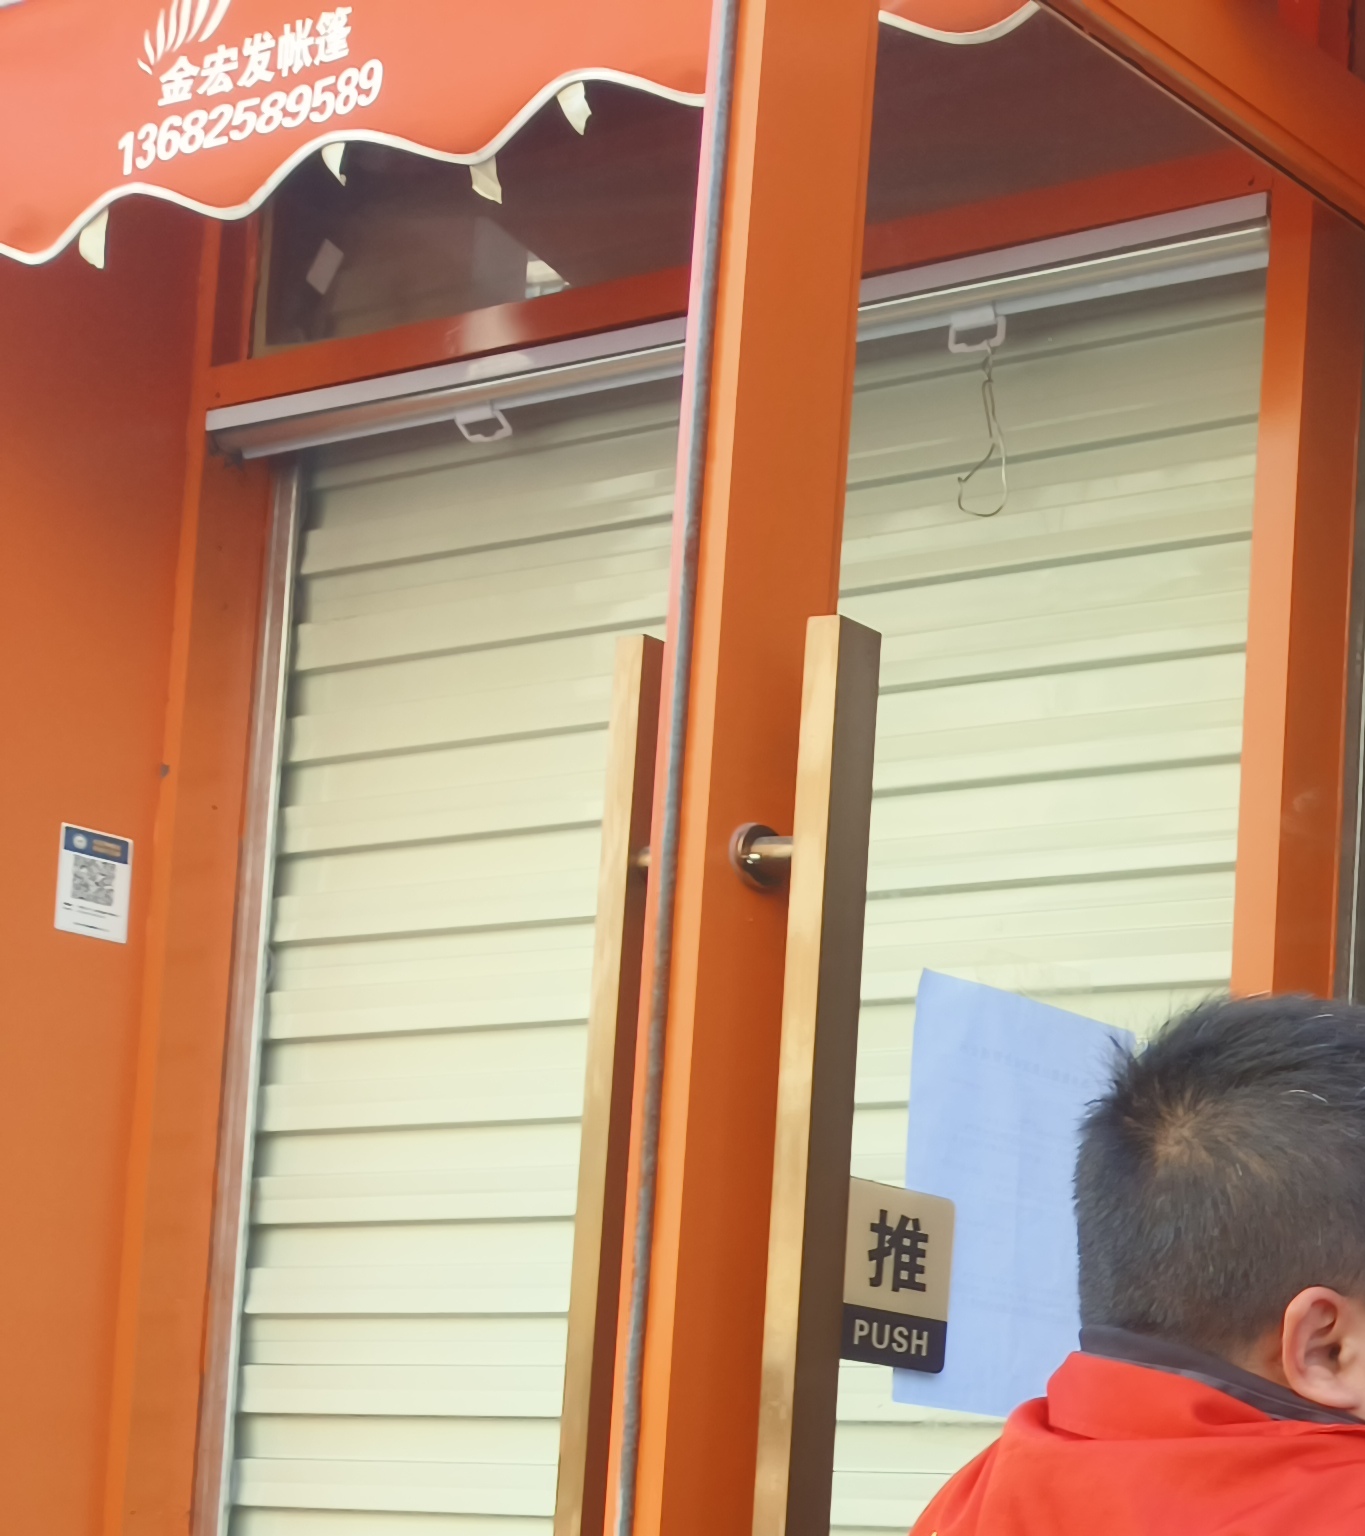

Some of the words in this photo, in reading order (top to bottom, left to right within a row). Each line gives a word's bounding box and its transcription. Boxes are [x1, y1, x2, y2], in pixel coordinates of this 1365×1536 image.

[157, 6, 353, 107] 金宏发帐篷
[118, 60, 385, 176] 13682589589
[867, 1209, 928, 1293] 推
[853, 1319, 929, 1356] PUSH
